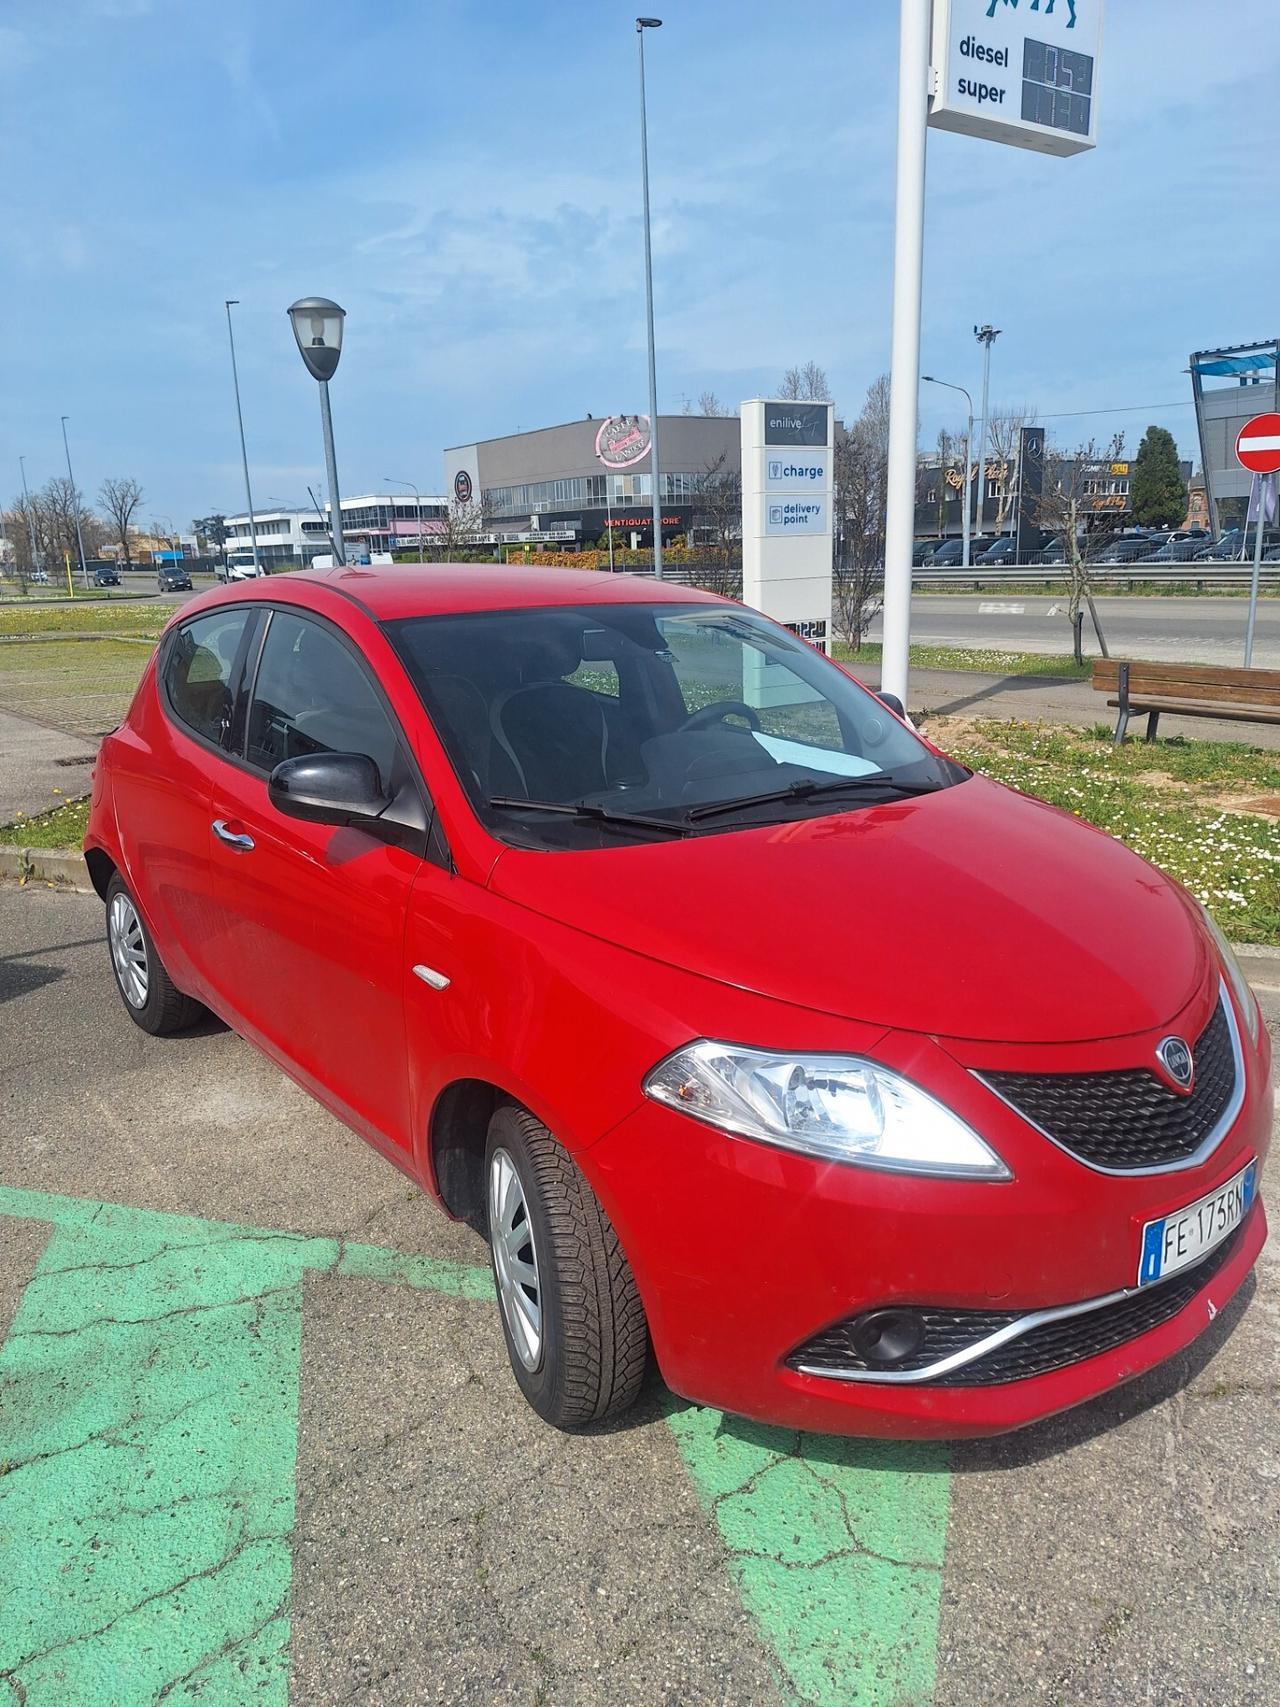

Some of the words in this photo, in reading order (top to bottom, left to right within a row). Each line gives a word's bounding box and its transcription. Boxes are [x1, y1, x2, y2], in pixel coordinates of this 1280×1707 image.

[959, 36, 1009, 67] diesel
[957, 78, 1006, 104] super
[769, 417, 803, 429] enilive
[783, 461, 824, 479] charge
[944, 464, 979, 490] Royl
[783, 503, 821, 516] delivery
[603, 516, 681, 527] VENTIQUATORE
[783, 513, 809, 526] point
